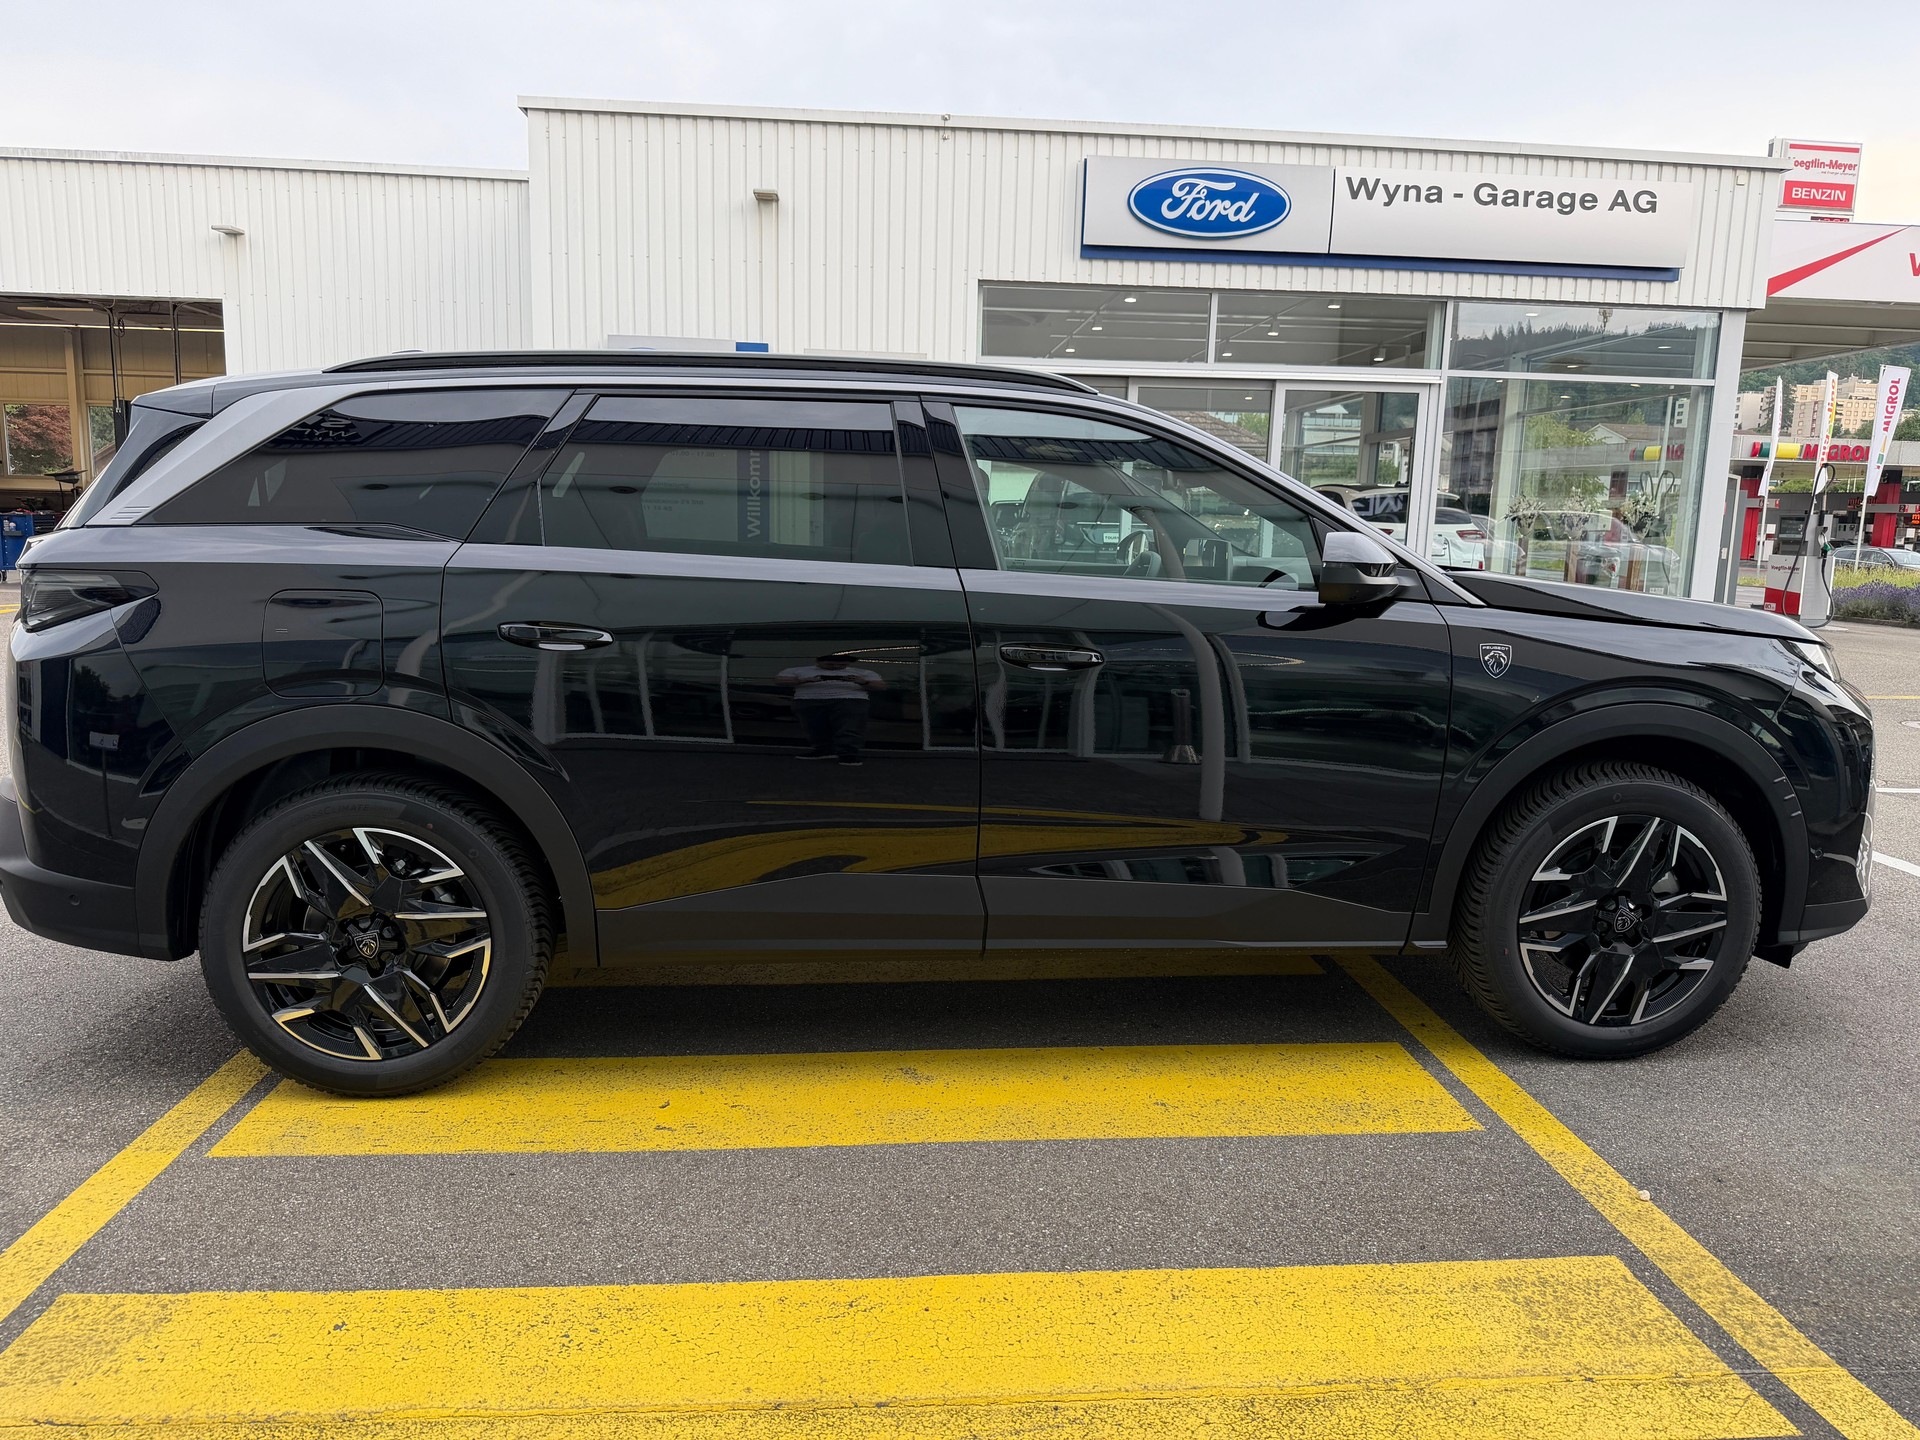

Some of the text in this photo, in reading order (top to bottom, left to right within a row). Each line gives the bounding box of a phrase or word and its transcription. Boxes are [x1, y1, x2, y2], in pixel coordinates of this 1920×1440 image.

[1788, 157, 1857, 172] oegtlin-Meyer
[1160, 178, 1259, 223] Ford
[1346, 177, 1443, 207] Wyna
[1473, 182, 1598, 216] Garage
[1607, 187, 1658, 214] AG
[1791, 187, 1846, 201] BENZIN
[1882, 377, 1901, 433] MIGROL
[1802, 443, 1871, 462] MGRO
